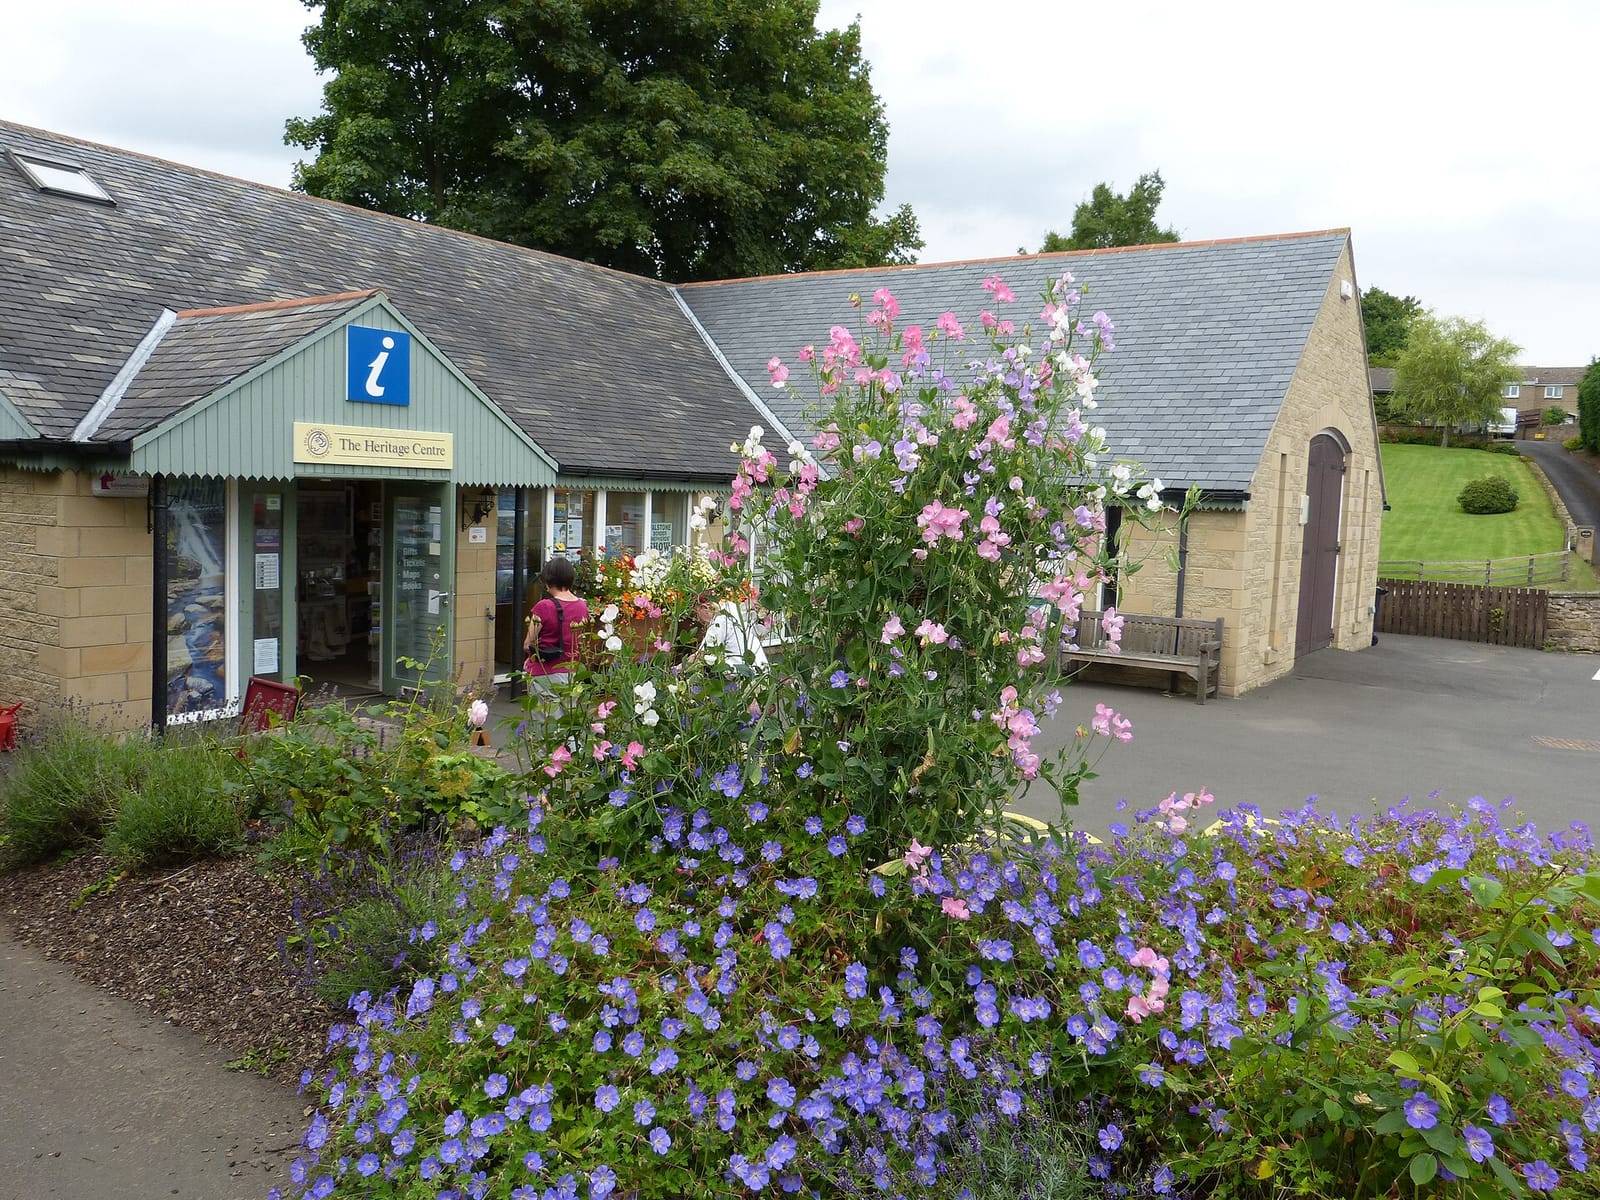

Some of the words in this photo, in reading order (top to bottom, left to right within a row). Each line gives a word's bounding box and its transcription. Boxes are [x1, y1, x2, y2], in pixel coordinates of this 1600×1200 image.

[365, 336, 395, 397] i
[339, 439, 361, 451] The
[365, 440, 409, 456] Heritage
[412, 443, 446, 456] Centre
[402, 558, 426, 567] Tickets
[402, 569, 421, 580] Maps
